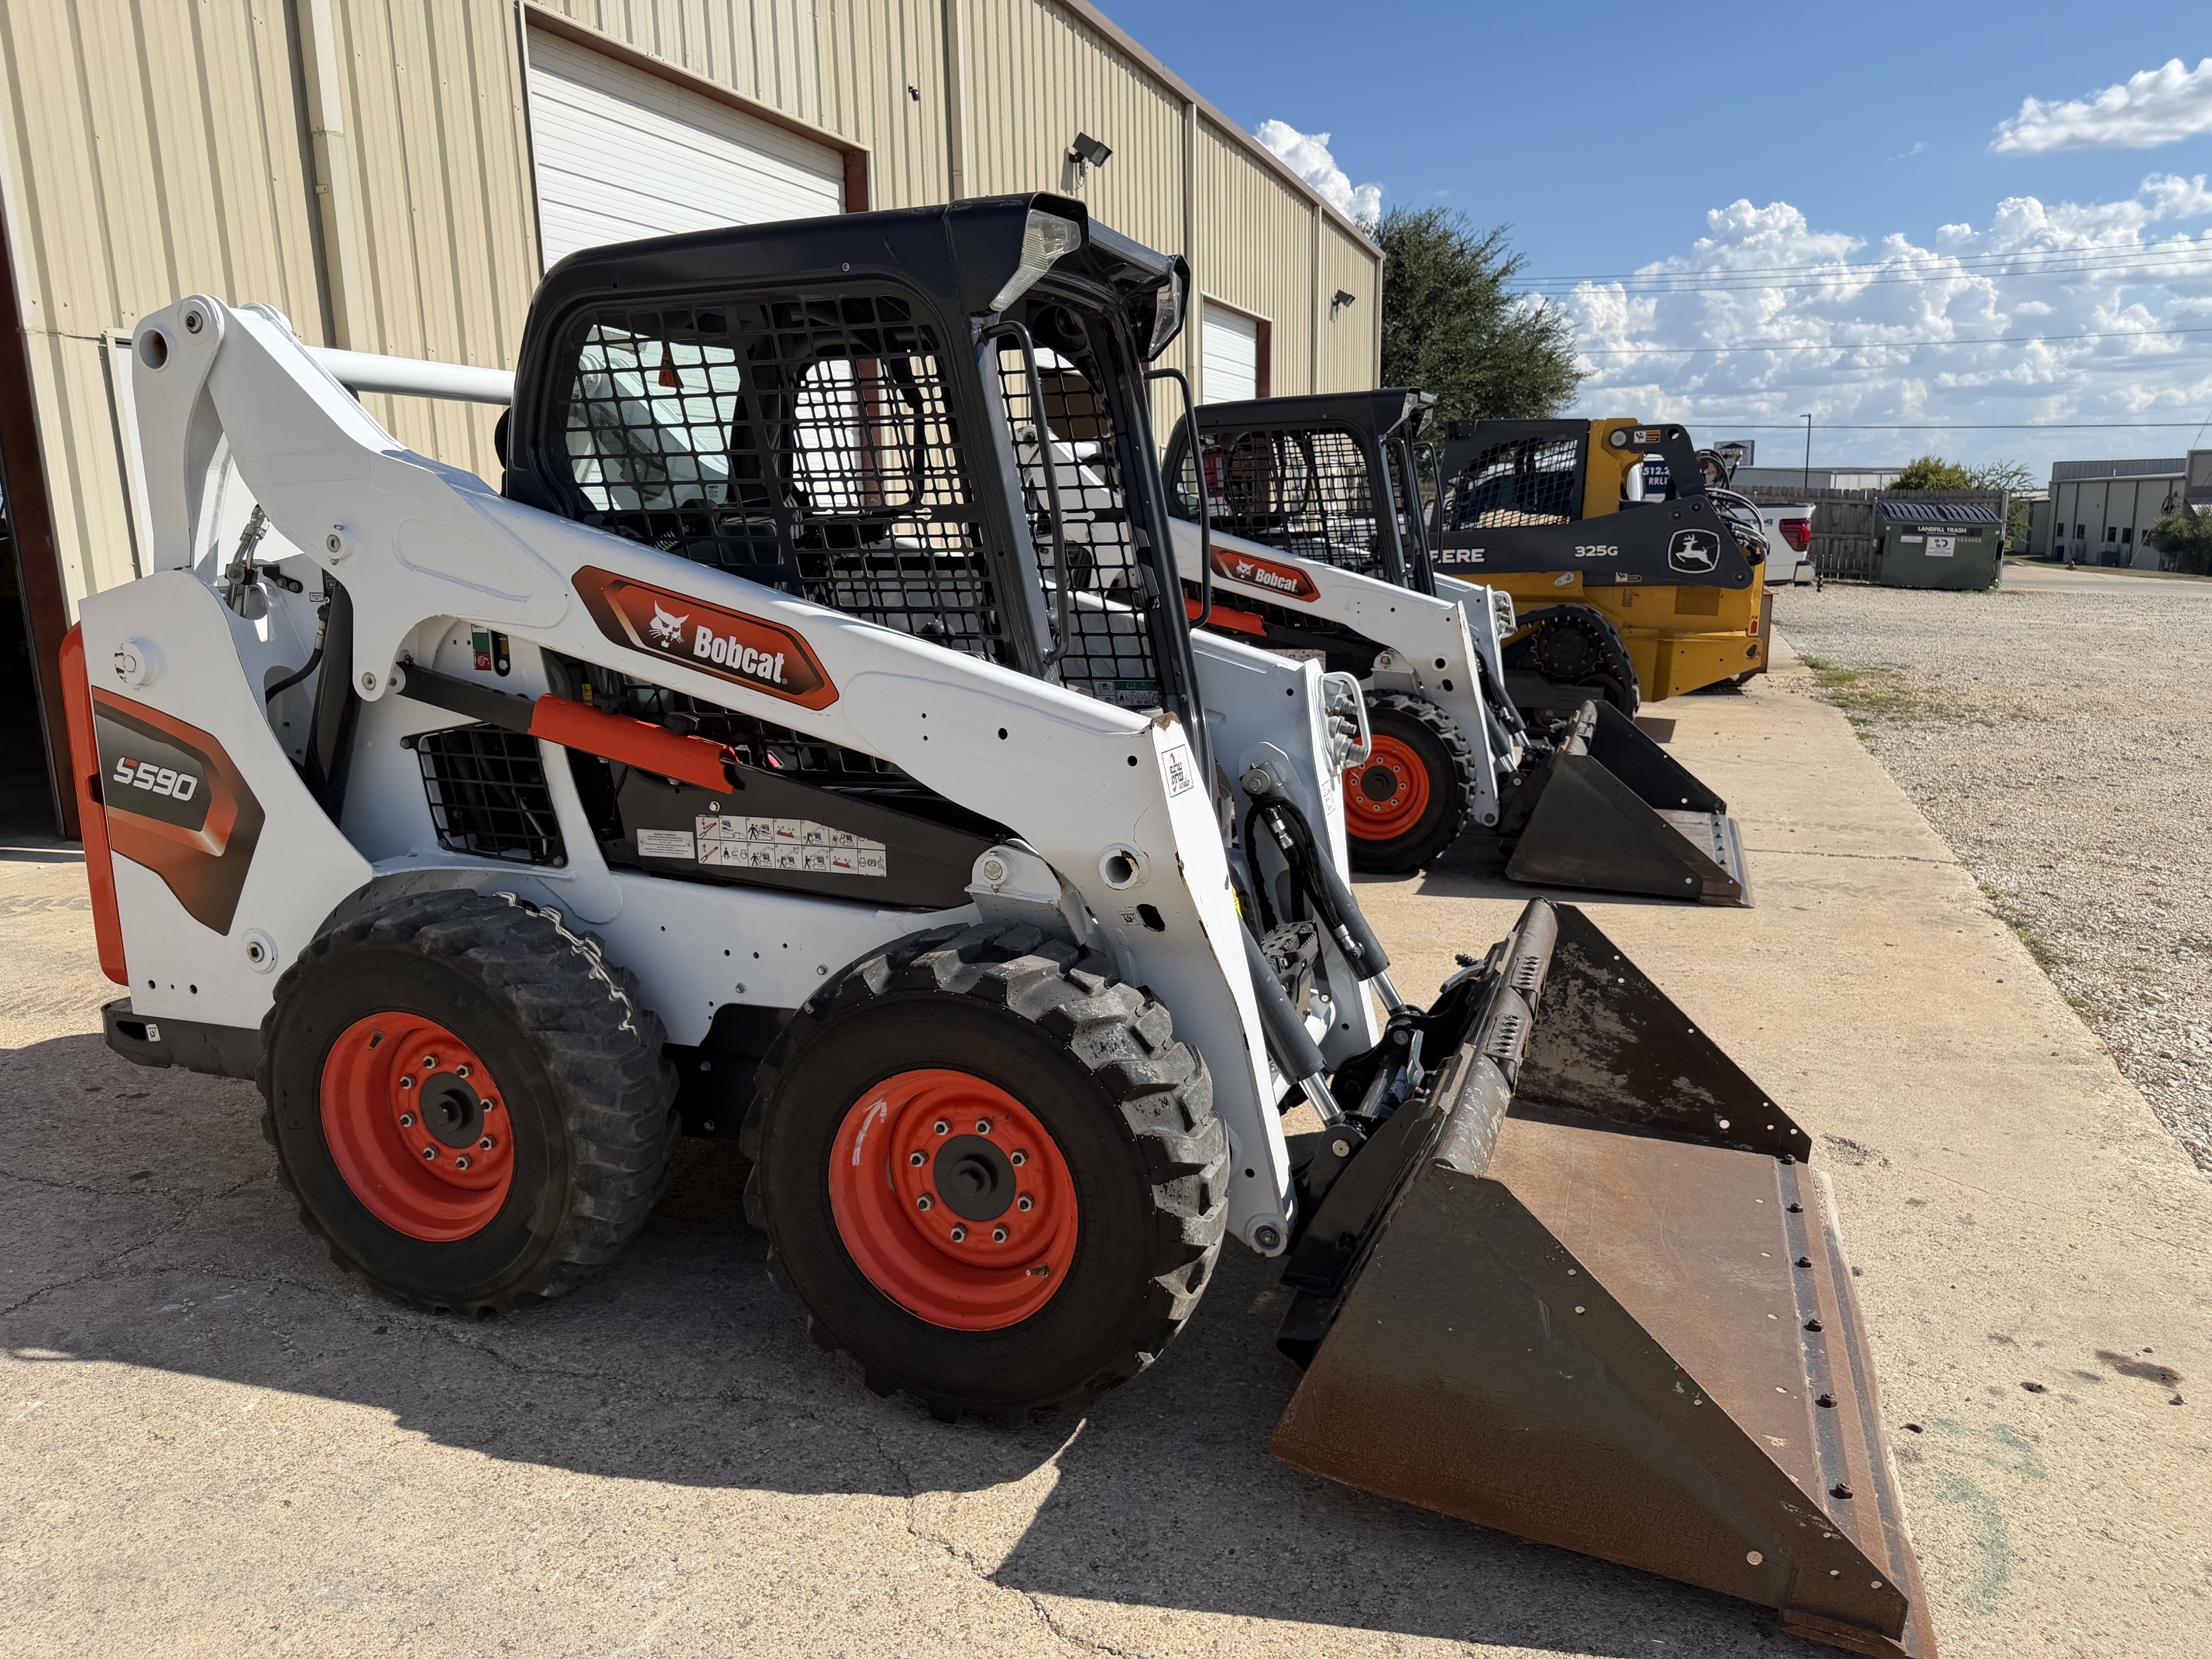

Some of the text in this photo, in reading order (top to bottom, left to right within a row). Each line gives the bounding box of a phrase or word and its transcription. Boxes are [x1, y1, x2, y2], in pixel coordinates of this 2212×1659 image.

[1575, 544, 1618, 557] 325G
[1255, 568, 1297, 592] Bobcat
[693, 625, 784, 684] Bobcat
[113, 757, 198, 801] S590
